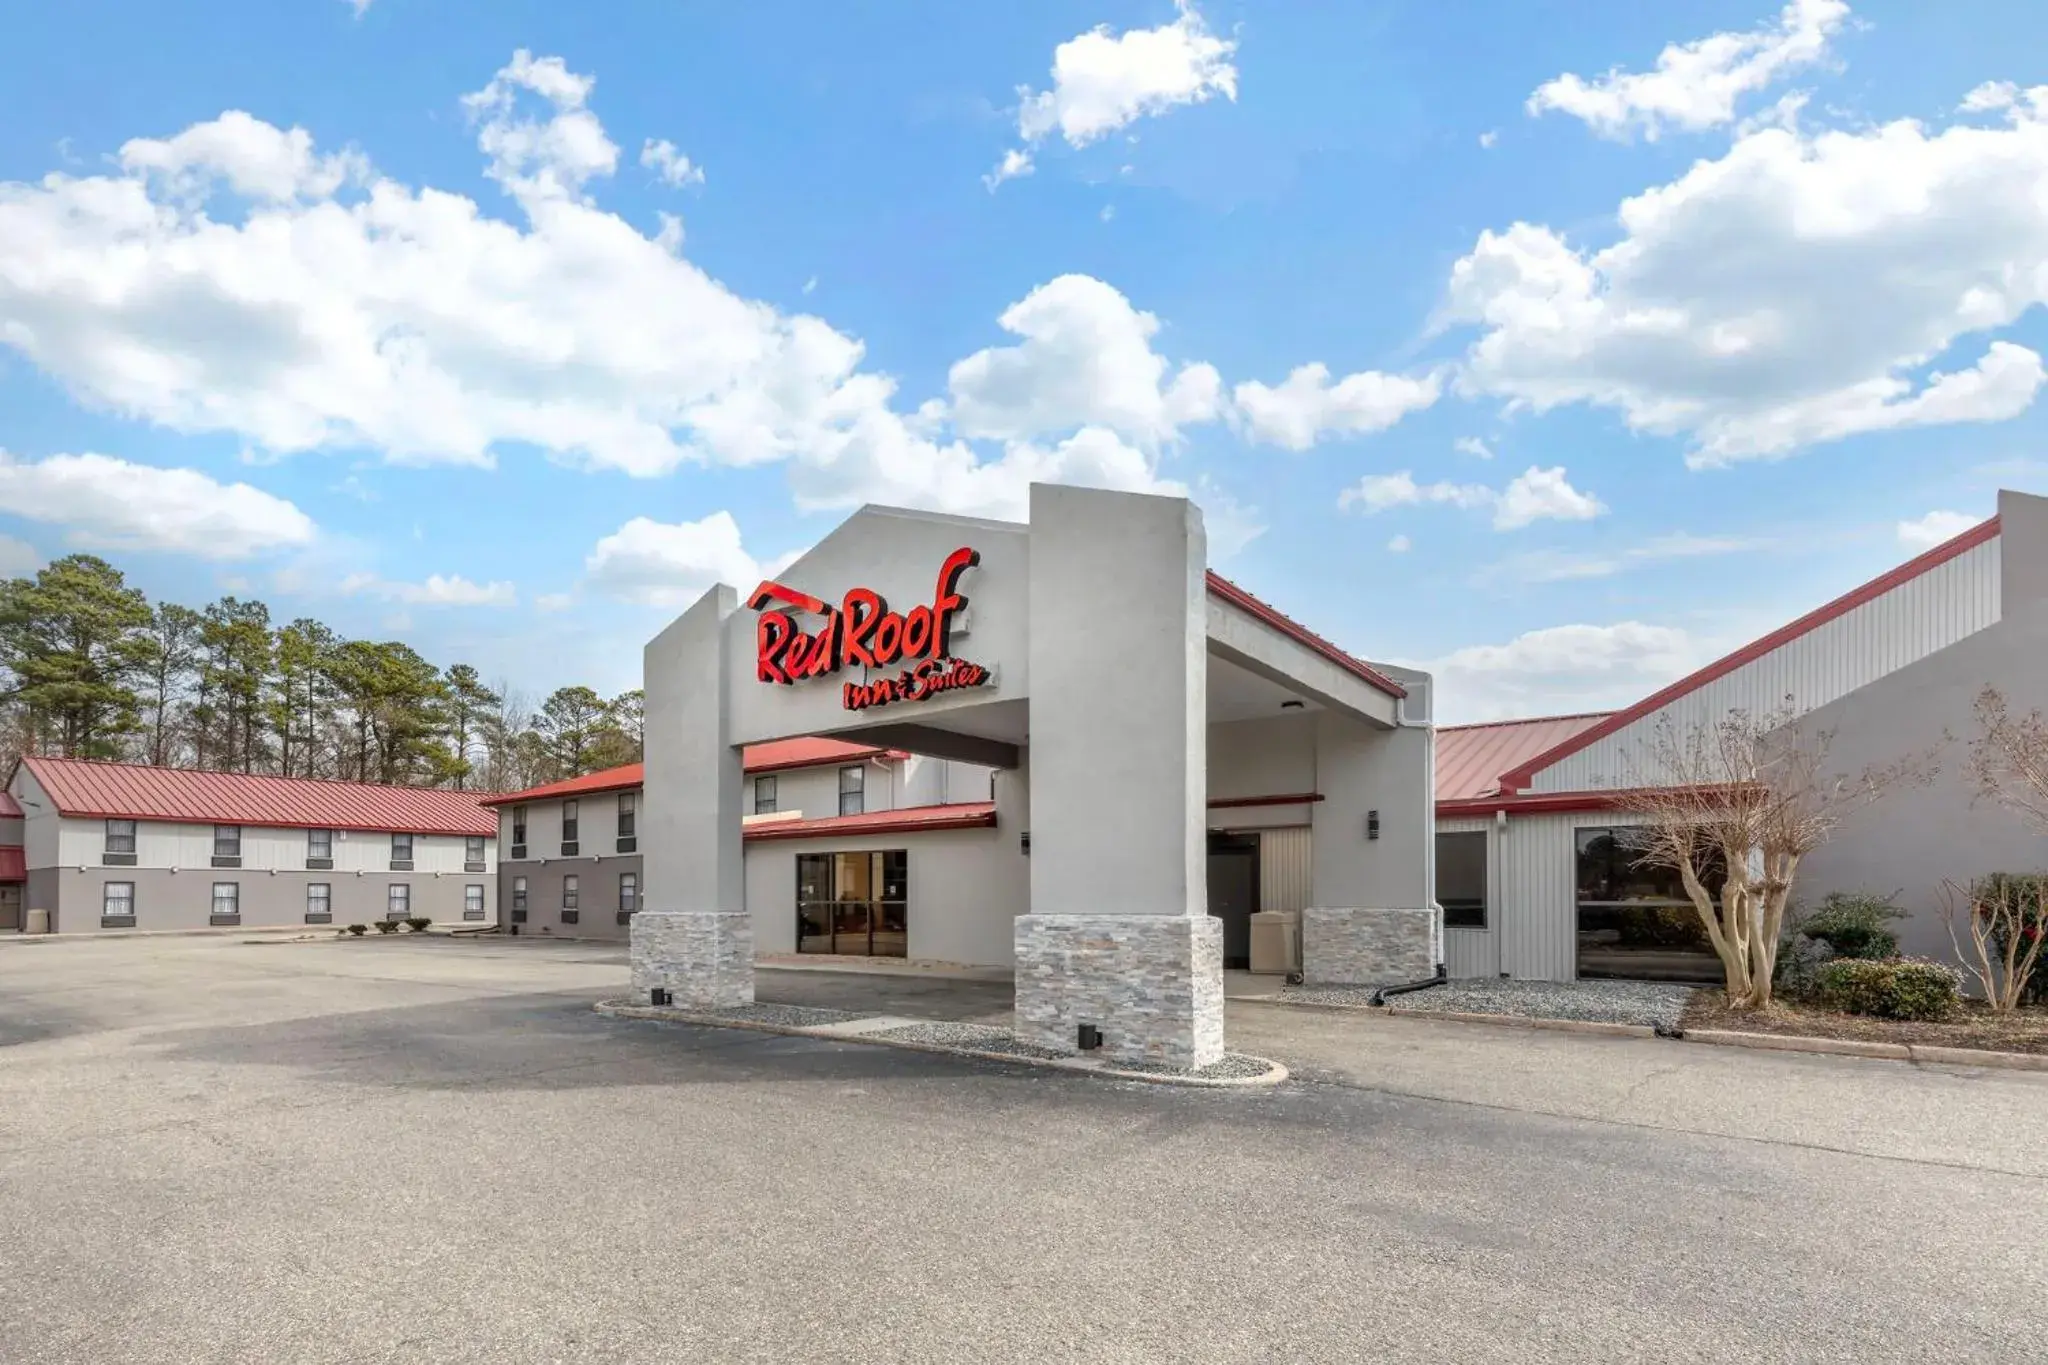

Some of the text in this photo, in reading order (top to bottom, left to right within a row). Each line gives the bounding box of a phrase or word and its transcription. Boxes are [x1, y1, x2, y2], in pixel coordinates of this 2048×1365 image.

[757, 547, 979, 684] Red Roof
[909, 657, 989, 701] Suites
